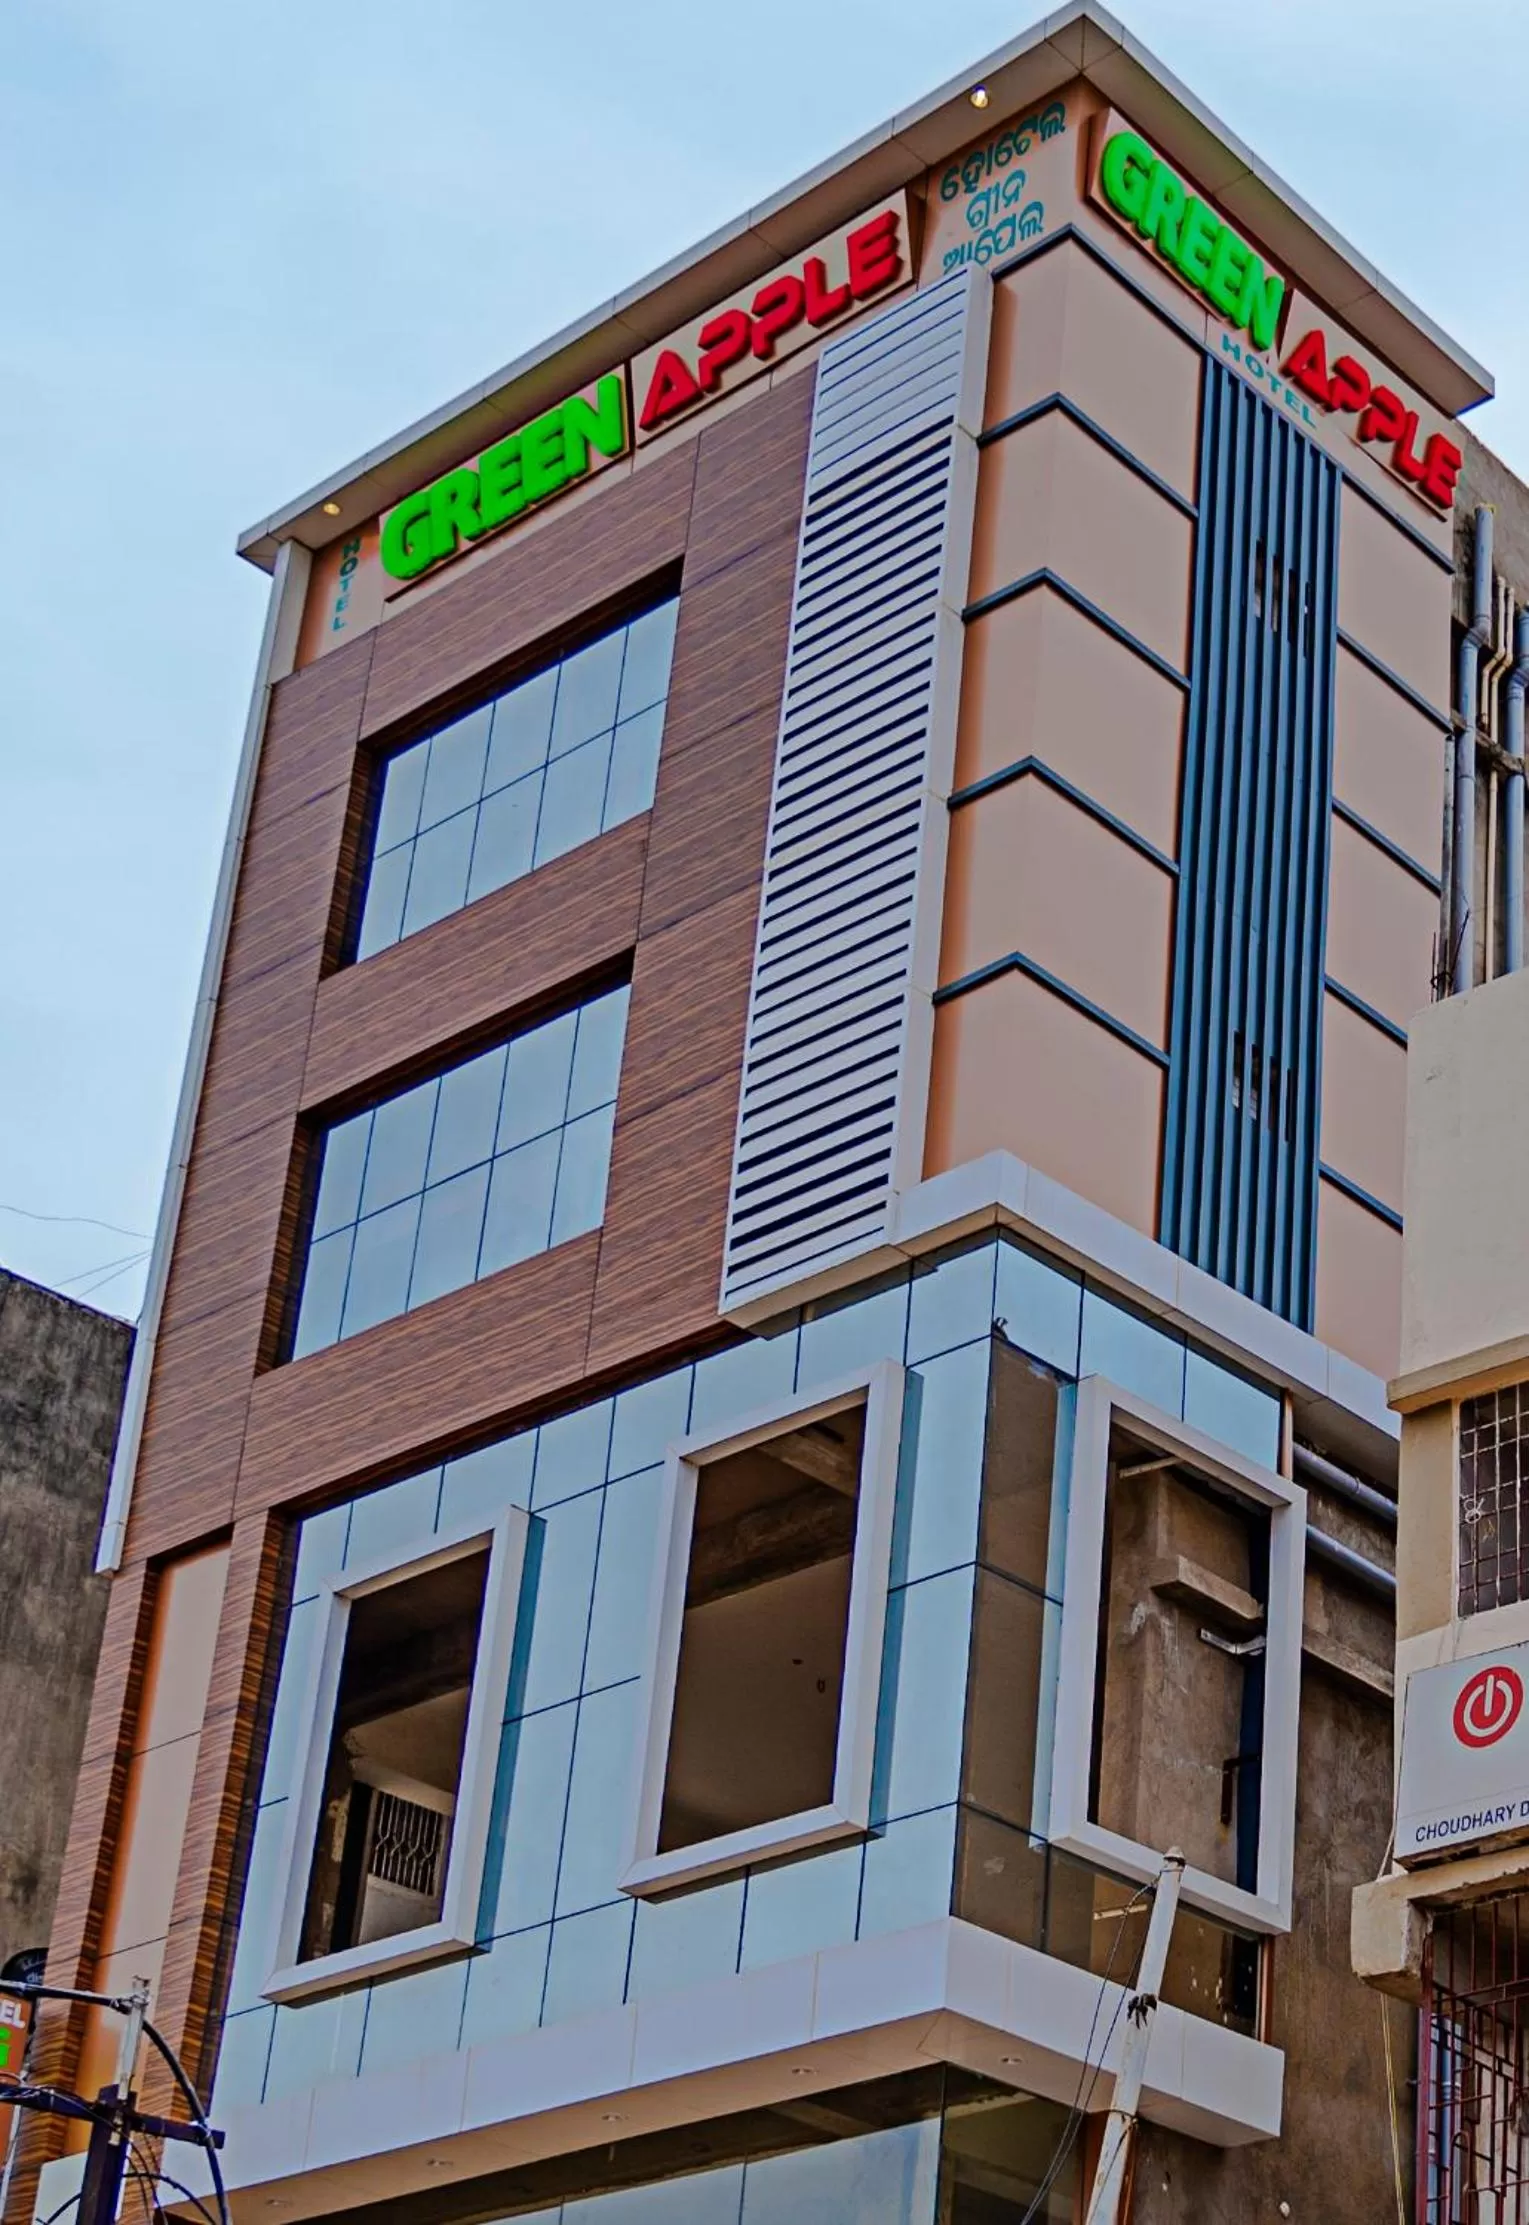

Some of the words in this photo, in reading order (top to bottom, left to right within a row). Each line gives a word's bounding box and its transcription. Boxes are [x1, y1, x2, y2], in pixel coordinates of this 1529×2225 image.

[1101, 131, 1285, 351] GREEN
[1280, 329, 1462, 509] APPLE
[380, 374, 625, 579] GREEN
[639, 210, 902, 429] APPLE
[1222, 333, 1317, 430] HOTEL
[332, 536, 362, 632] HOTEL
[1416, 1803, 1516, 1841] CHOUDHARY
